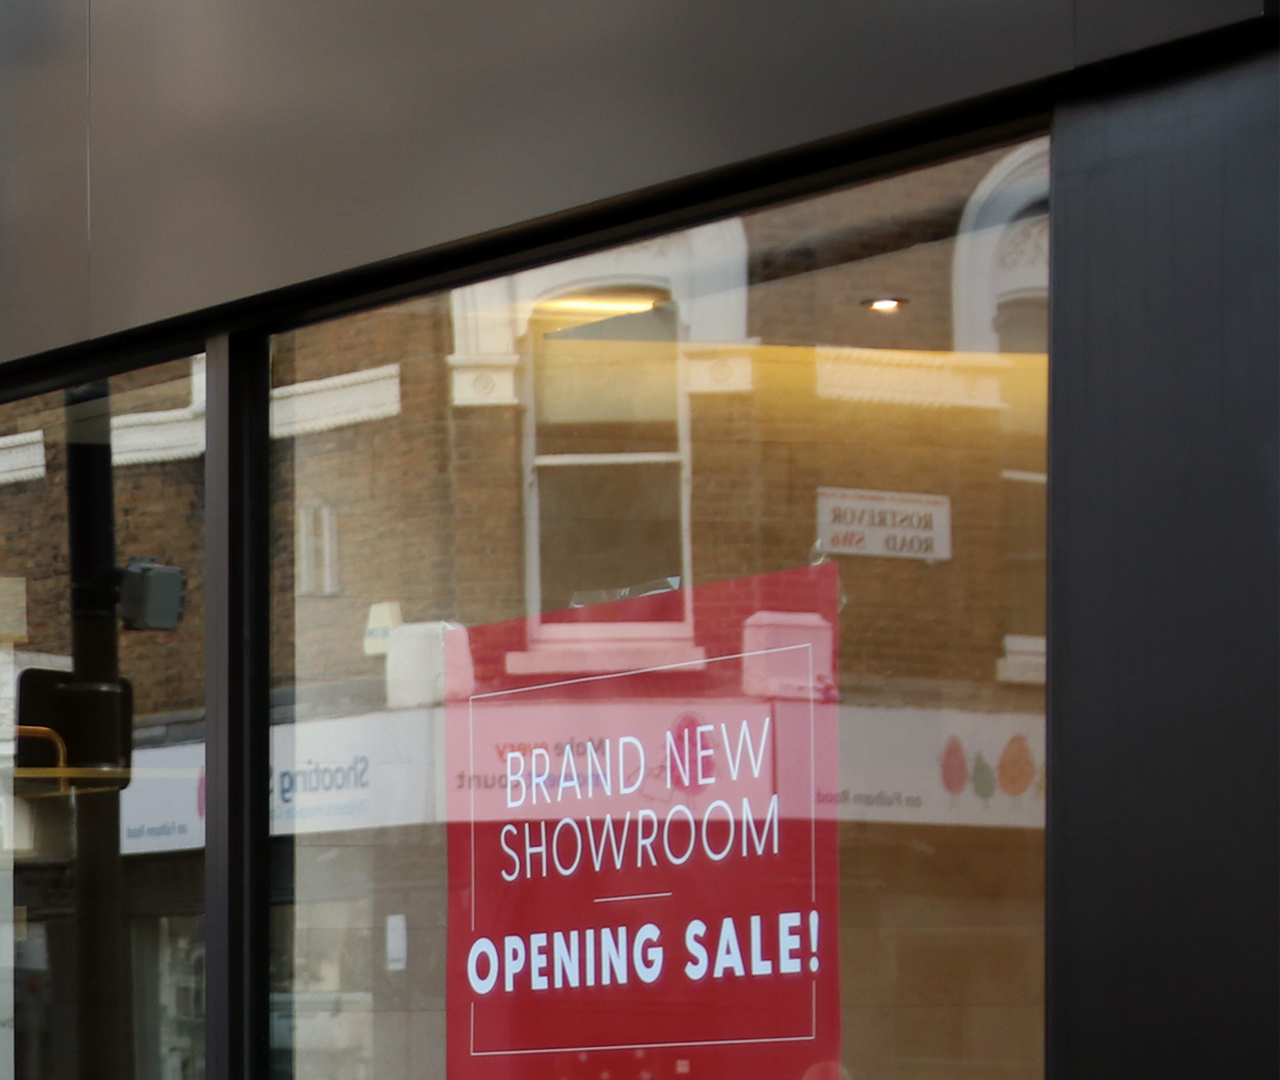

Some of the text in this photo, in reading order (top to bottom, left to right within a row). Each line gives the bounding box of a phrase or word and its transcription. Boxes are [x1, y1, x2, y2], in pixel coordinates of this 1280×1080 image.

[506, 716, 771, 809] BRAND NEW
[500, 793, 780, 883] SHOWROOM
[466, 909, 821, 995] OPENING SALE!
